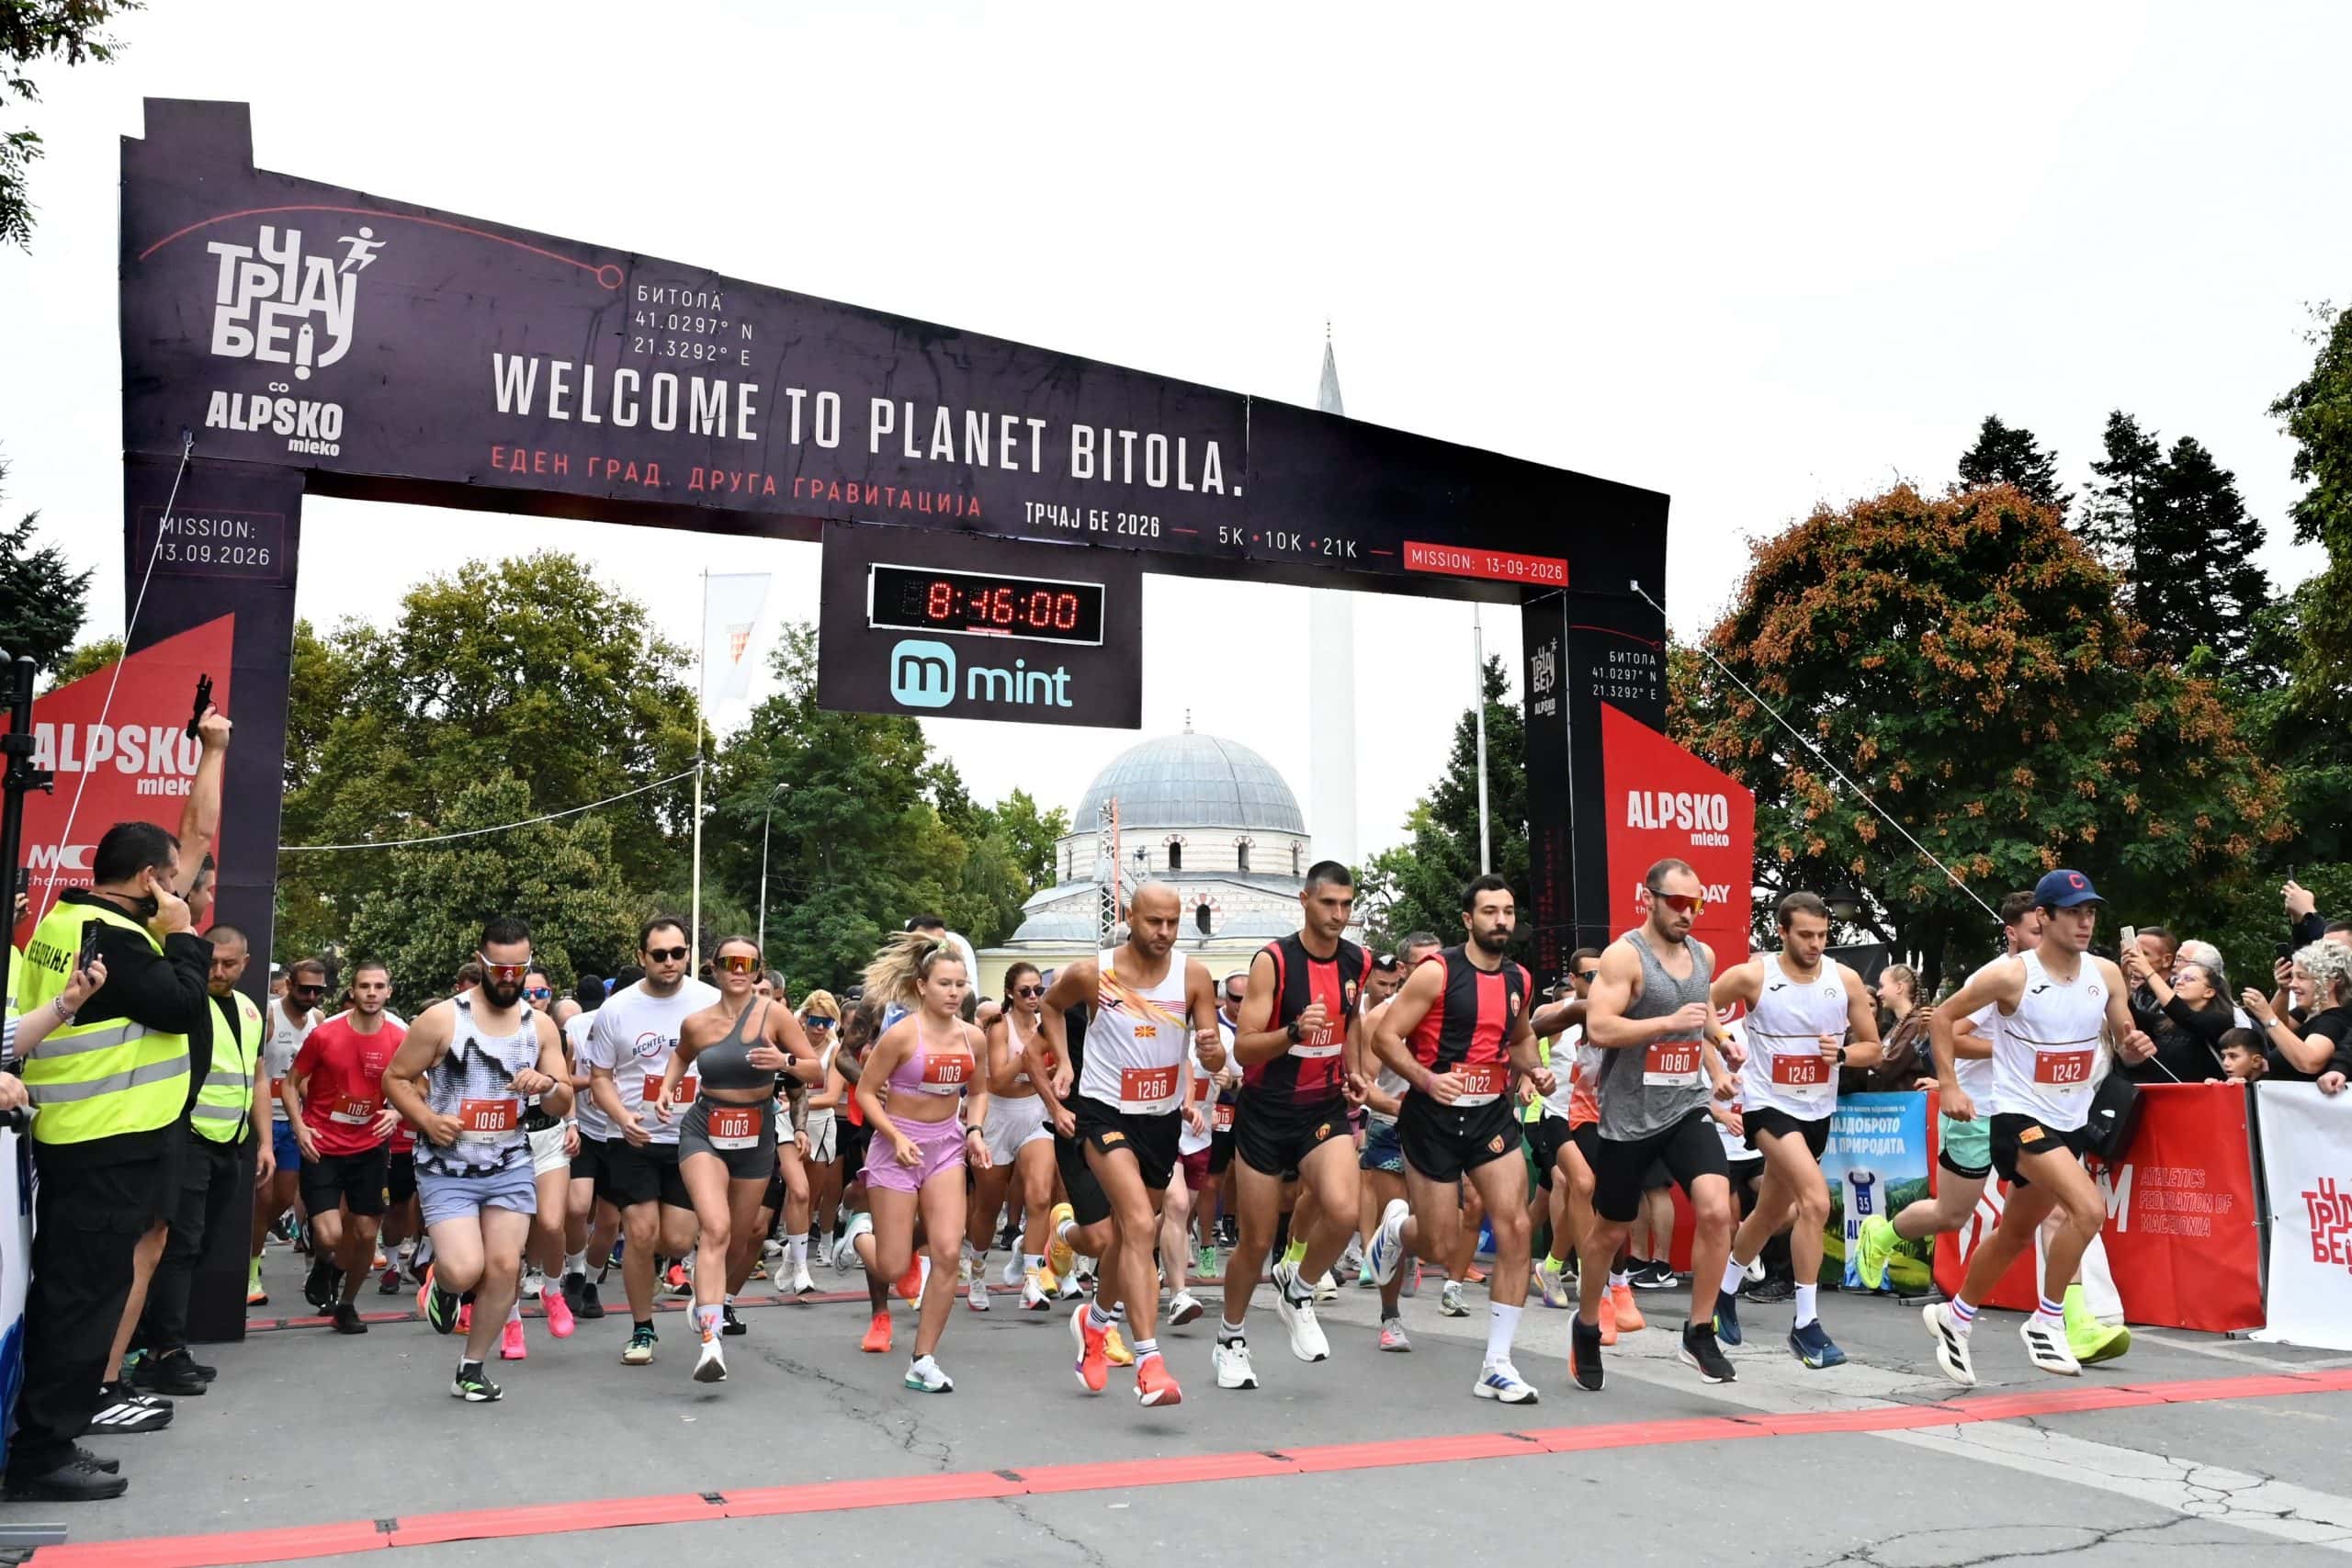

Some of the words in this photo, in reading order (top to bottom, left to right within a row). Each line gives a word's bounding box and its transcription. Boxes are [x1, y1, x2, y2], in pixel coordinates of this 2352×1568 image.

[638, 285, 721, 311] БИТОЛА
[636, 310, 728, 334] 41.0297°
[741, 323, 752, 340] N
[634, 336, 728, 361] 21.3292°
[741, 350, 751, 366] E
[205, 389, 344, 441] ALPSKO
[492, 352, 759, 442] WELCOME
[786, 387, 841, 448] TO
[870, 397, 1047, 473] PLANET
[1071, 423, 1243, 497] BITOLA.
[288, 437, 340, 457] mleko
[491, 446, 569, 475] ЕДЕН
[588, 457, 672, 487] ГРАД.
[688, 467, 776, 496] ДРУГА
[793, 477, 982, 517] ГРАВИТАЦИЈА
[159, 516, 256, 539] MISSION:
[1024, 502, 1081, 529] ТРЧАЈ
[1089, 509, 1109, 532] БЕ
[1117, 512, 1160, 537] 2026
[1265, 530, 1302, 551] 10K
[1323, 537, 1358, 558] 21K
[157, 543, 270, 566] 13.09.2026
[1411, 548, 1476, 570] MISSION:
[1486, 558, 1563, 580] 13-09-2026
[1610, 650, 1656, 665] БИТОЛА
[967, 659, 1073, 707] mint
[1649, 671, 1657, 682] N
[1650, 689, 1657, 700] E
[137, 776, 194, 796] mlek
[1627, 790, 1729, 831] ALPSKO
[1690, 831, 1730, 847] mleko
[2069, 874, 2086, 889] C
[632, 1034, 666, 1056] BECHTEL
[1660, 1054, 1690, 1072] 1080
[2052, 1063, 2081, 1082] 1242
[938, 1066, 961, 1082] 1103
[1788, 1066, 1815, 1083] 1243
[1464, 1076, 1490, 1093] 1022
[347, 1102, 369, 1116] 1182
[475, 1111, 505, 1130] 1086
[720, 1119, 749, 1136] 1003
[1839, 1137, 1905, 1156] ПРИРОДАТА
[2140, 1168, 2205, 1189] ATHLETICS
[2215, 1194, 2233, 1213] OF
[2140, 1213, 2211, 1236] MACEDONIA
